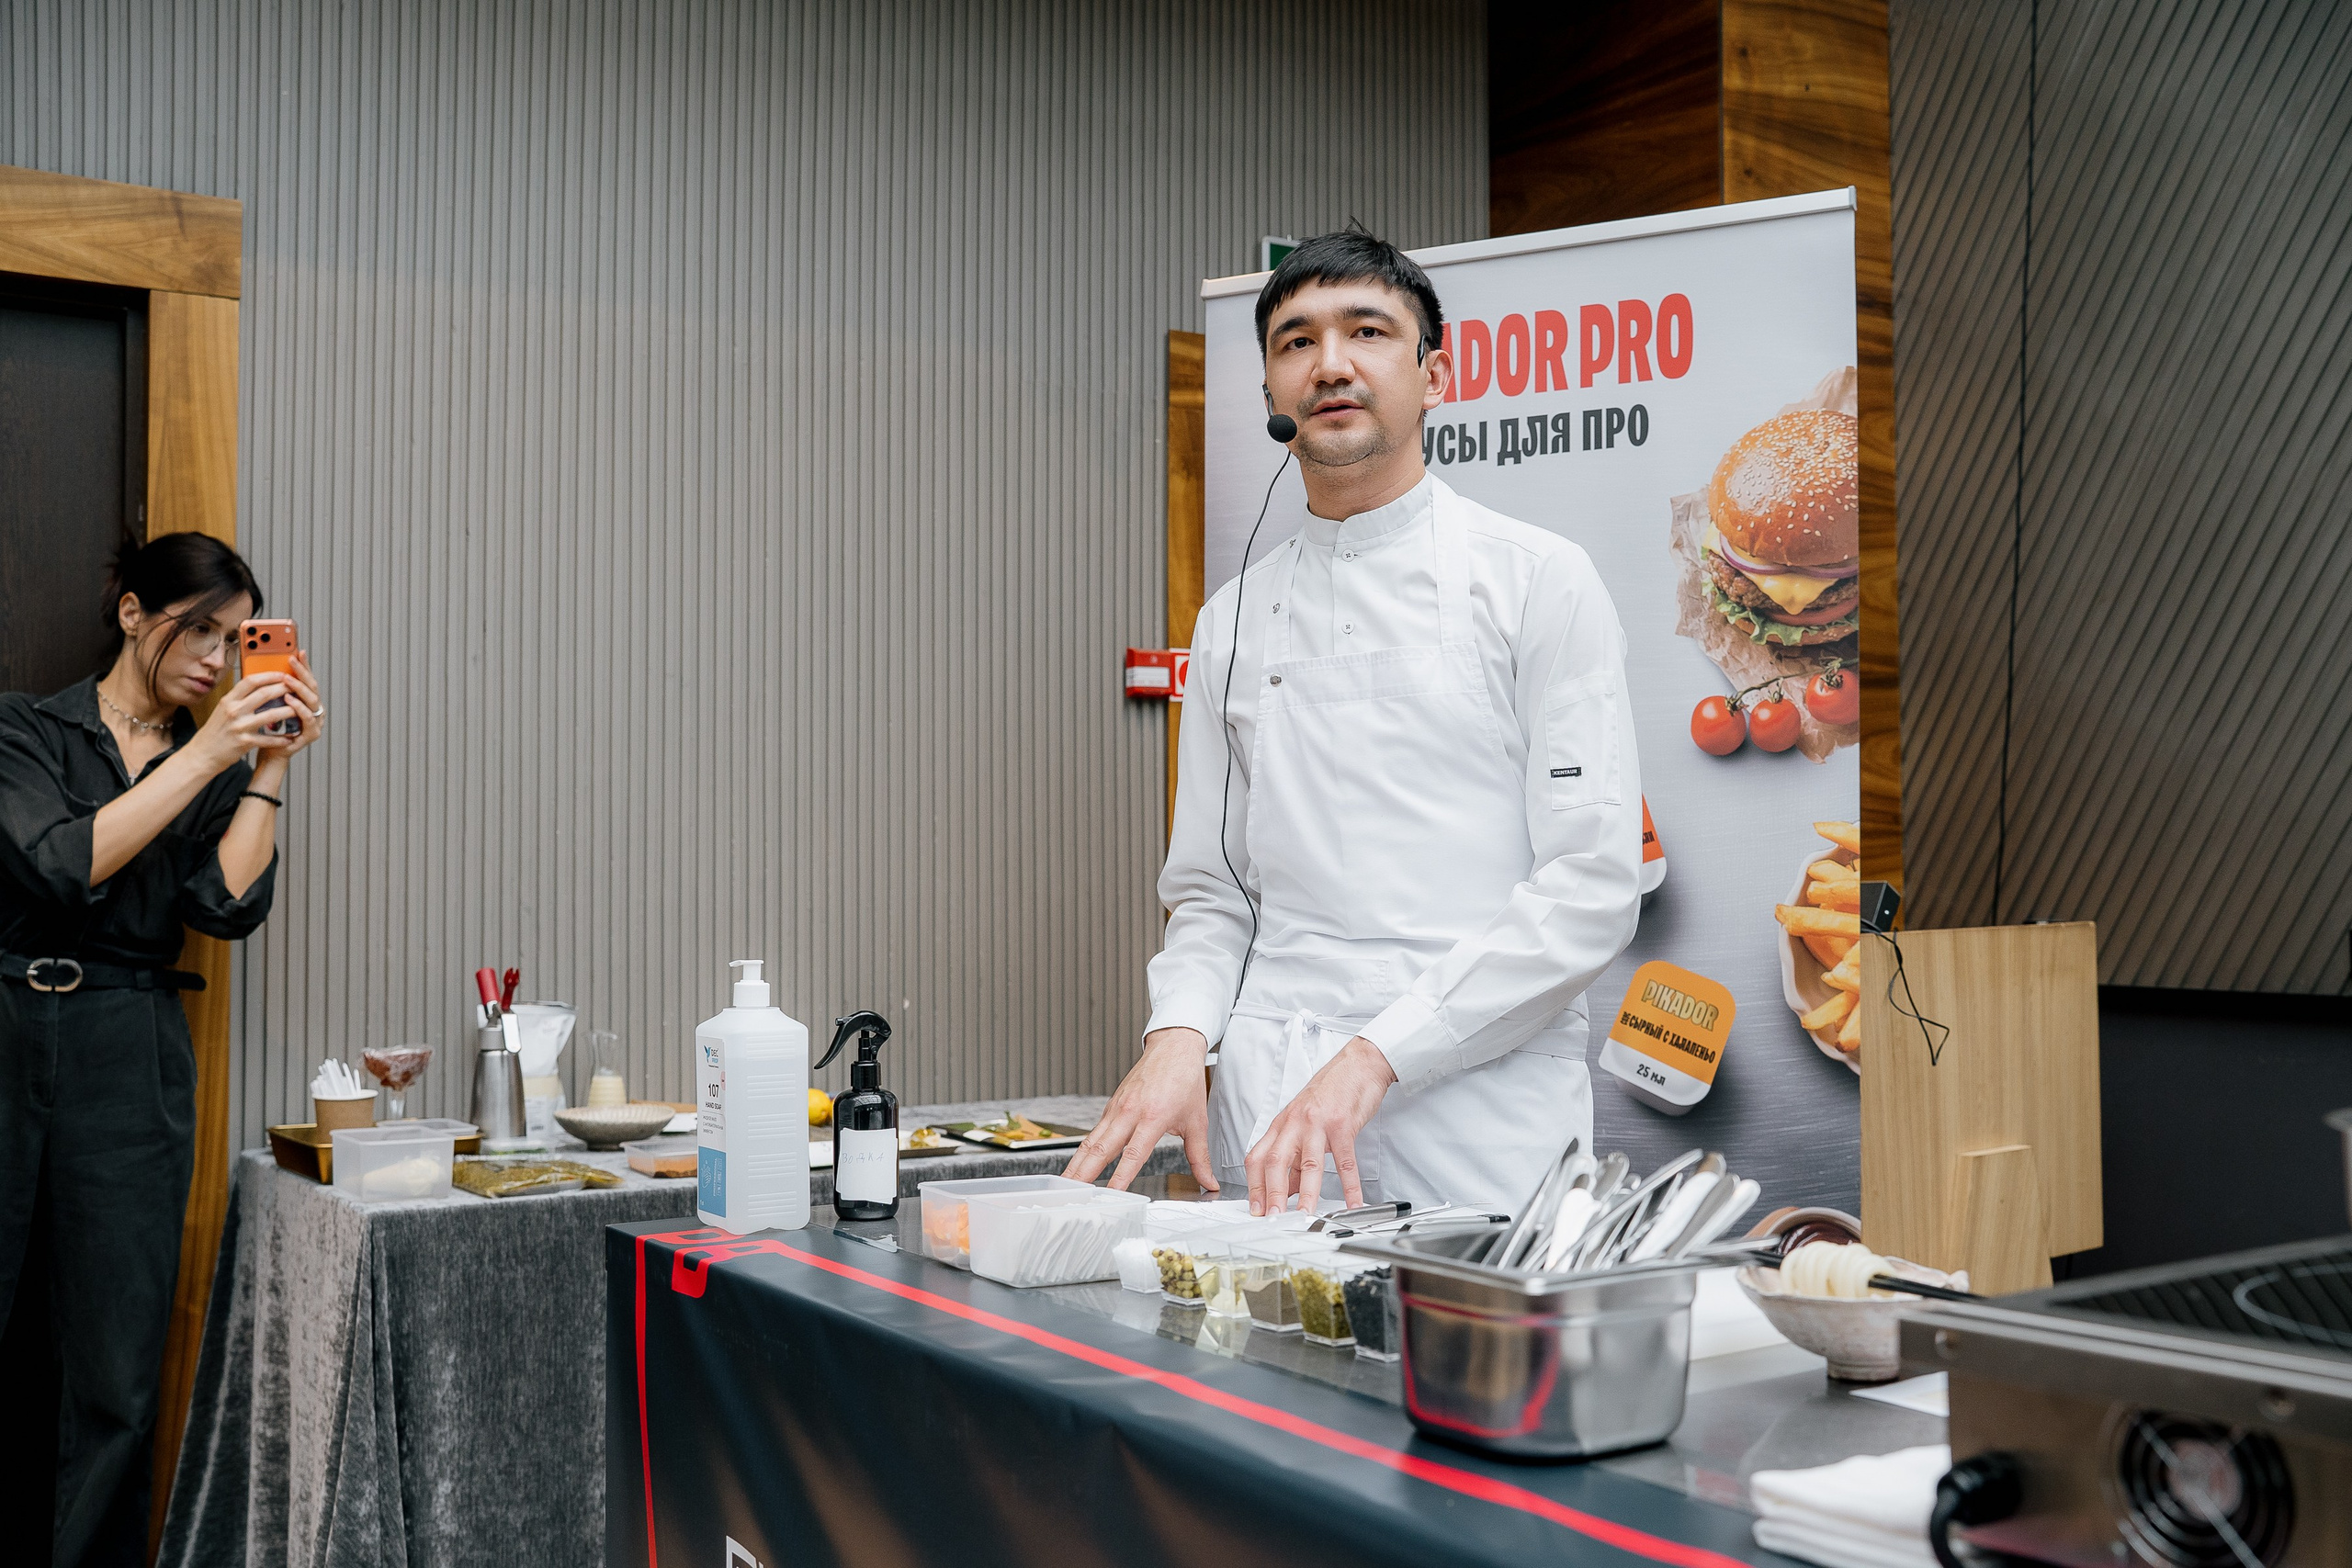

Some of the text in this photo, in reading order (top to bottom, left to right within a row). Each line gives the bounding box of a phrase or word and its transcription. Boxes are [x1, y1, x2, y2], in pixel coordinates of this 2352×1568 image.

[1580, 293, 1693, 388] PRO
[1498, 412, 1570, 466] ДЛЯ
[1583, 404, 1649, 451] ПРО
[1641, 979, 1719, 1032] PIKADOR
[1629, 1015, 1664, 1041] СЫРНЫЙ
[1668, 1032, 1716, 1064] ХАЛАПЕНЬО
[707, 1083, 719, 1098] 107
[1636, 1064, 1651, 1077] 25
